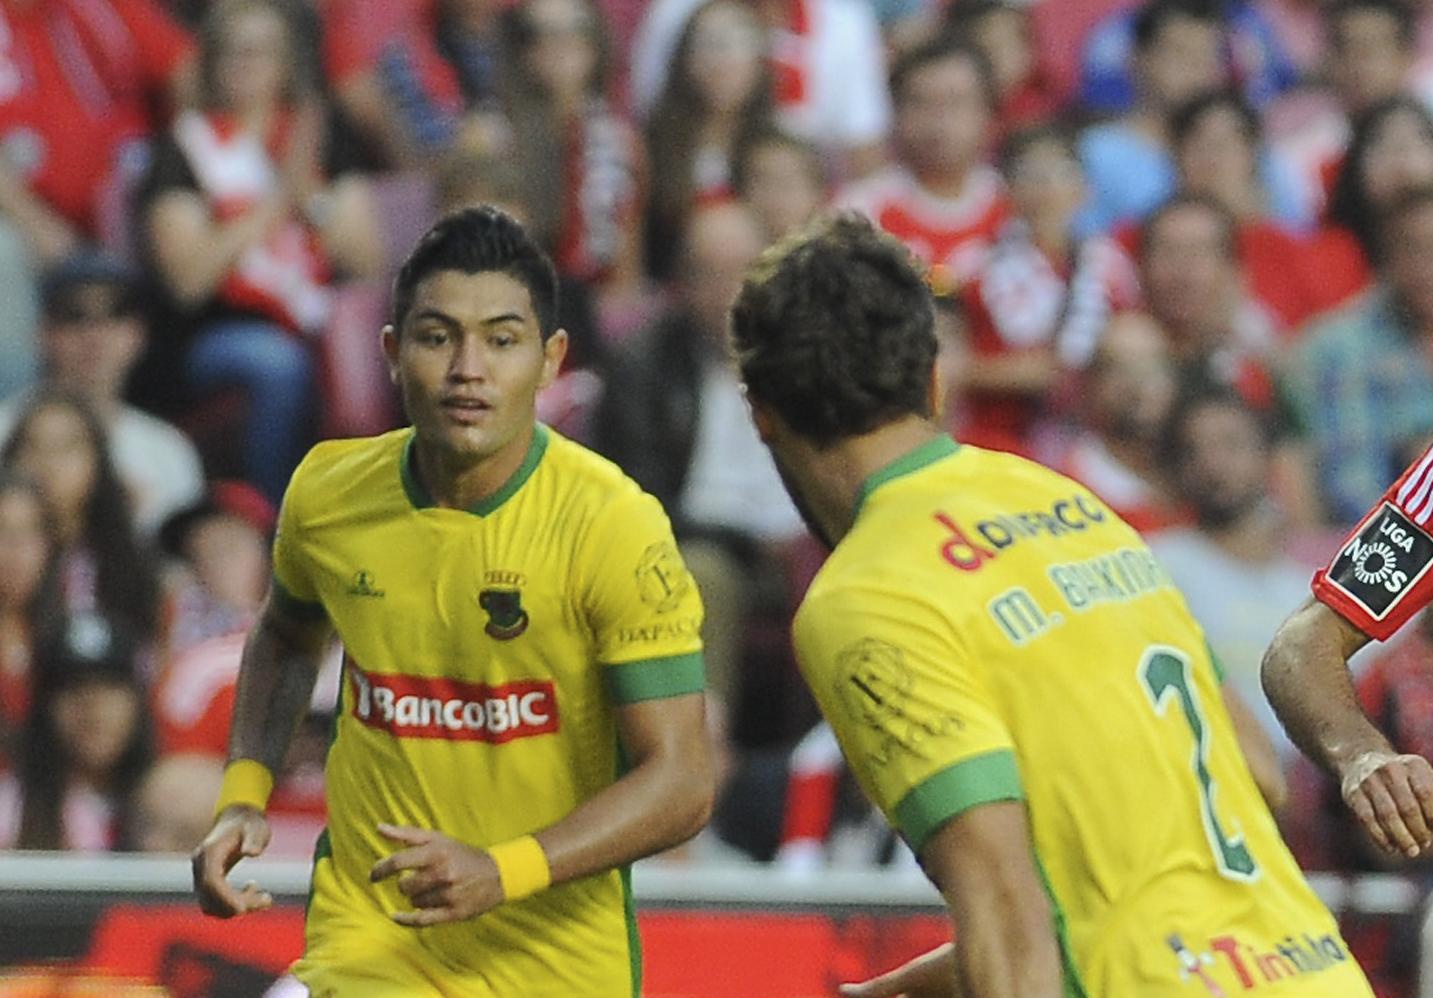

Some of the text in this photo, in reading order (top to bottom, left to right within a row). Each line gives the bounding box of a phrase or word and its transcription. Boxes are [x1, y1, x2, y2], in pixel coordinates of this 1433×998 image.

[1379, 516, 1415, 553] LIGA
[1344, 537, 1408, 593] NOS
[1137, 644, 1259, 882] 2
